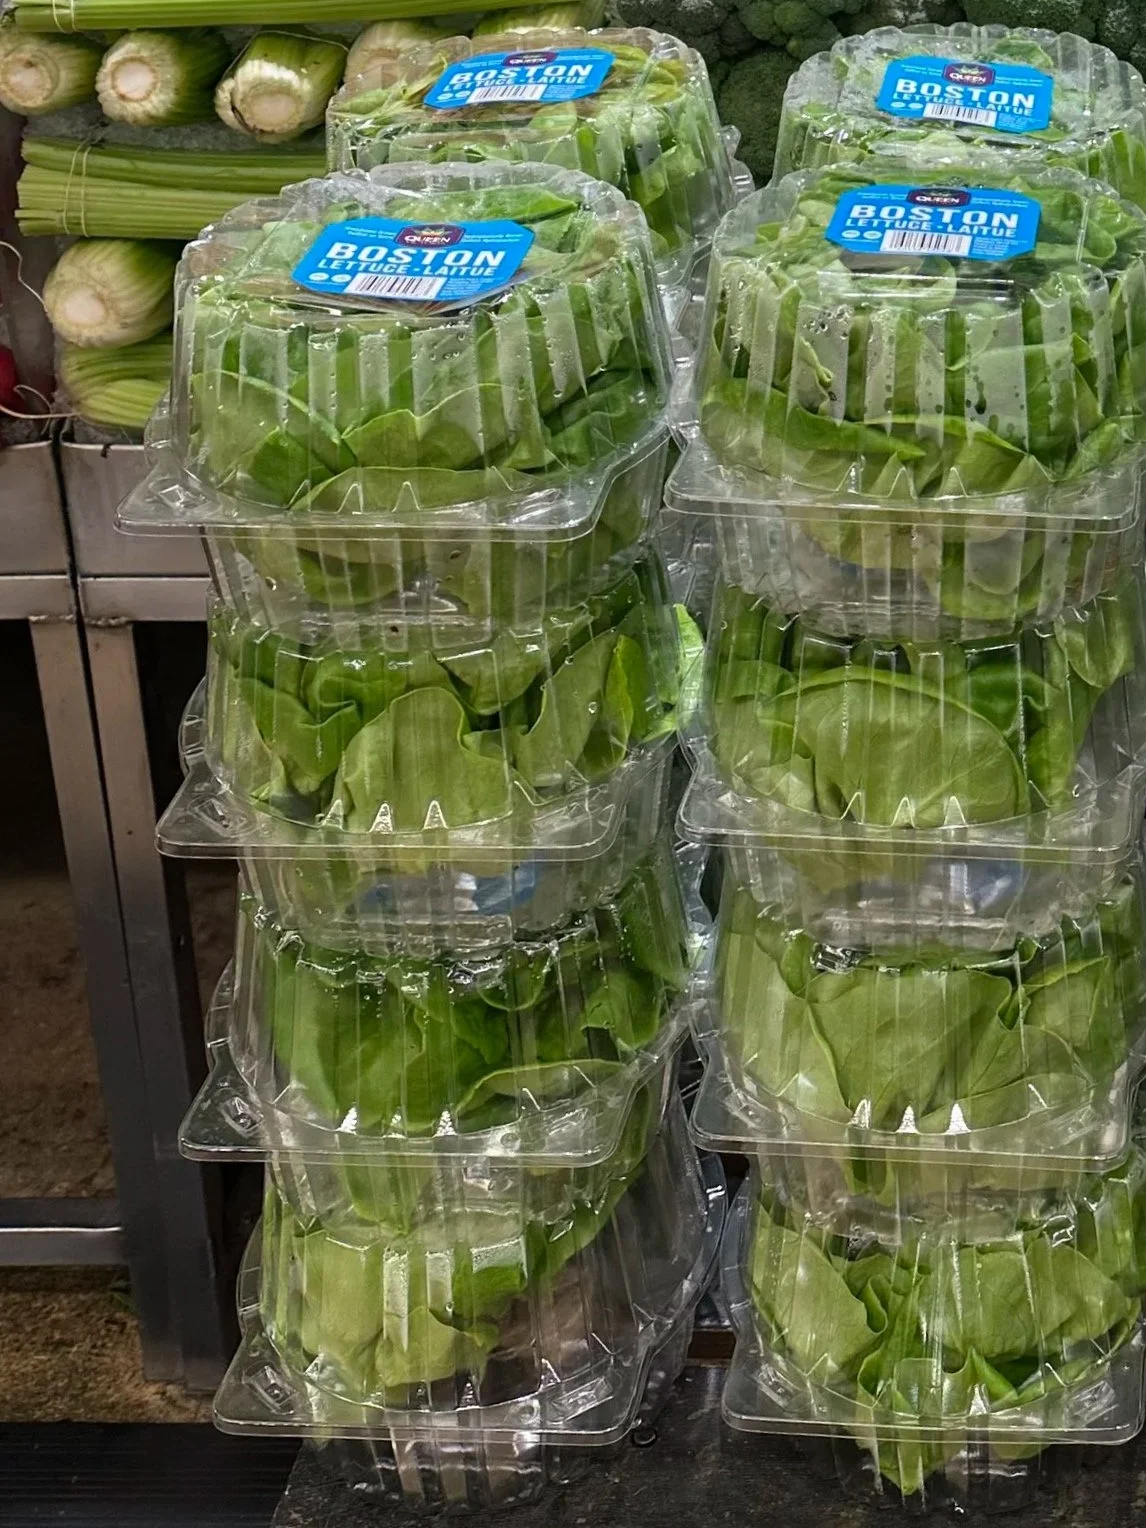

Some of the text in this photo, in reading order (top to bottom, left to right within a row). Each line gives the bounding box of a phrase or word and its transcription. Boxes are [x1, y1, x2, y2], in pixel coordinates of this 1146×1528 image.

[442, 75, 588, 92] LETTUCE LAITUE
[451, 64, 593, 85] BOSTON
[949, 72, 987, 83] QUEEN
[895, 78, 1036, 109] BOSTON
[892, 92, 1035, 117] LETTUCE LAITUE
[915, 195, 960, 204] QUEEN
[849, 204, 1019, 229] BOSTON
[845, 219, 1017, 238] LETTUCE LAITUE
[404, 234, 452, 245] QUEEN
[325, 241, 506, 268] BOSTON
[317, 258, 498, 277] LETTUCE LAITUE
